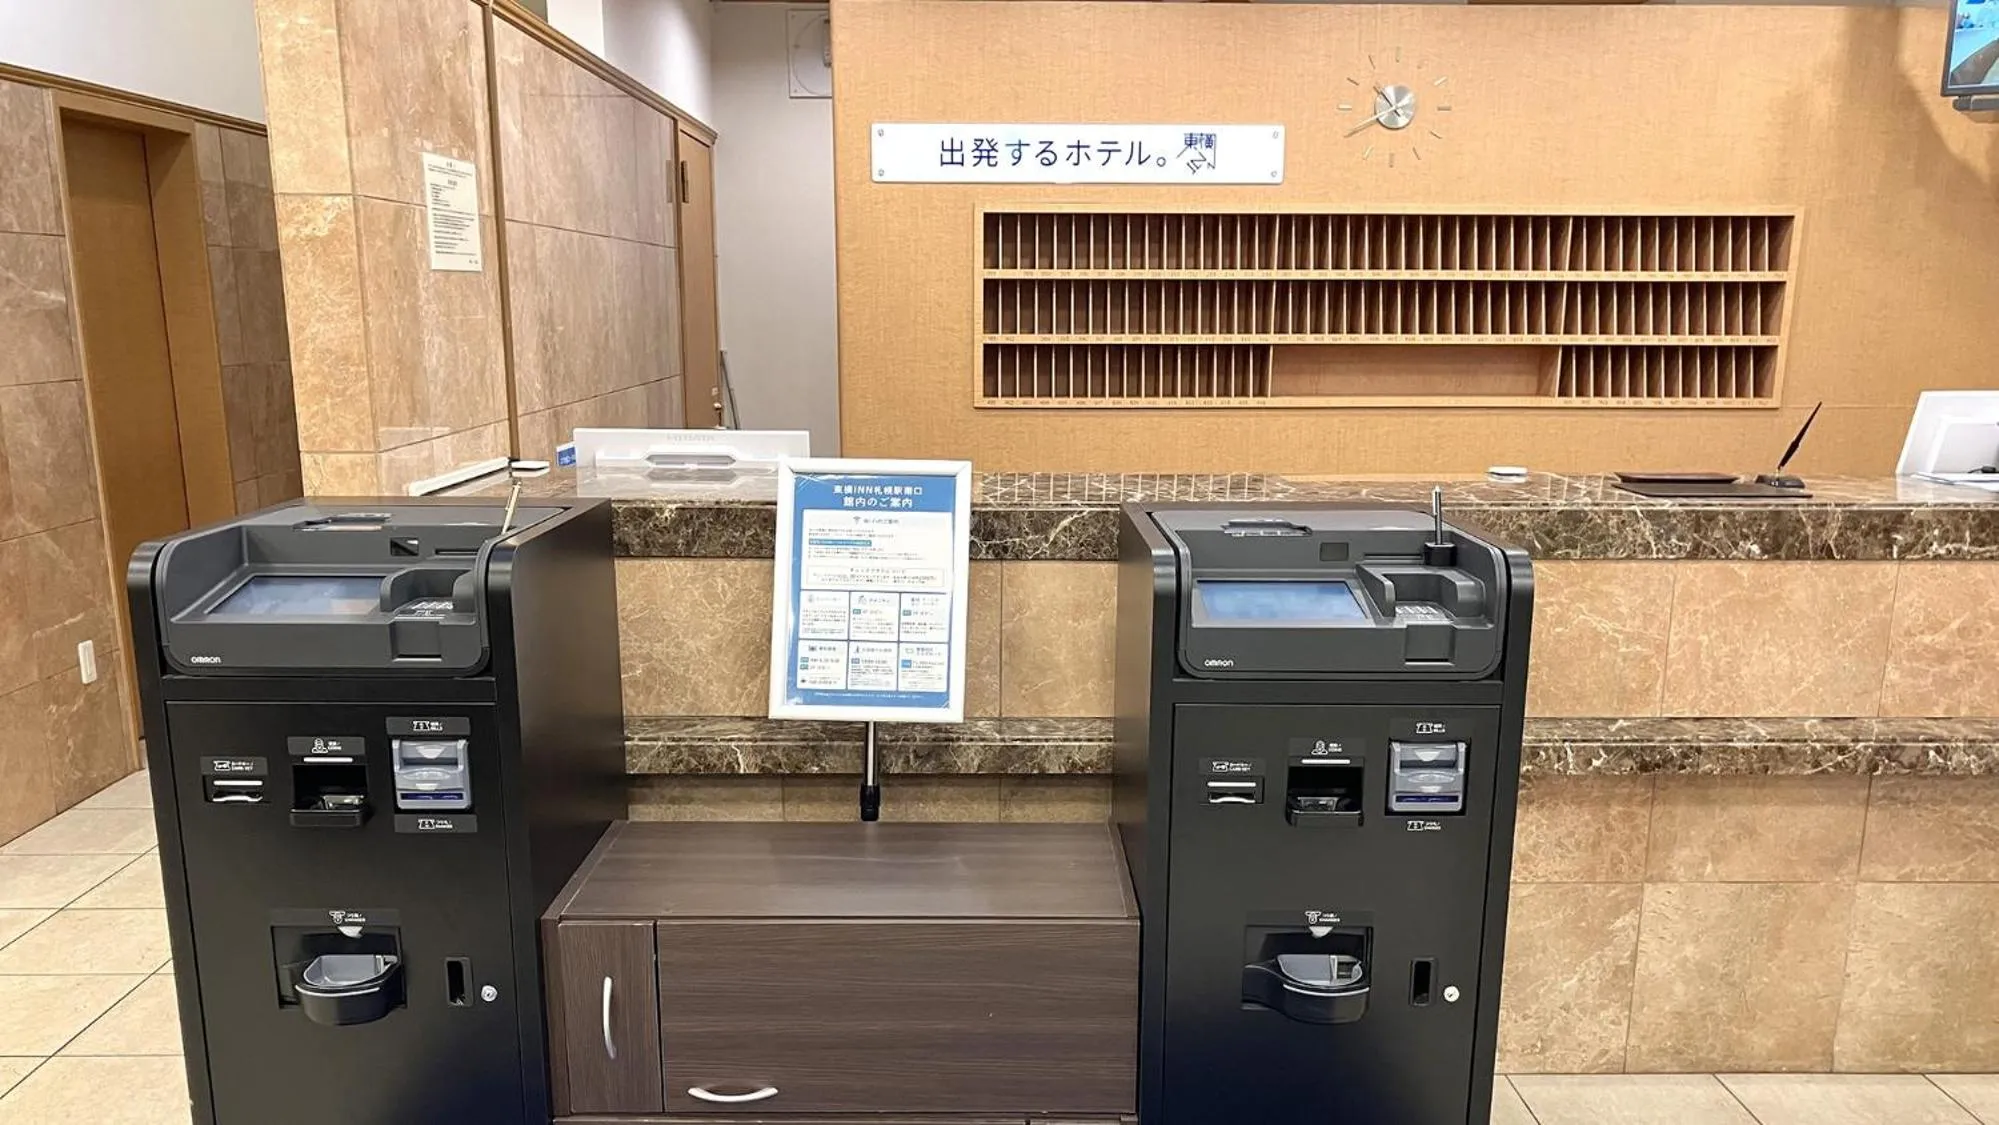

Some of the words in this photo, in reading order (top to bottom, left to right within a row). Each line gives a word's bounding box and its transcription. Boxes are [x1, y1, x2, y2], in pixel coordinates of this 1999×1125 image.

[939, 137, 1167, 168] 出発するホテル。
[843, 497, 913, 509] 館内のご案内
